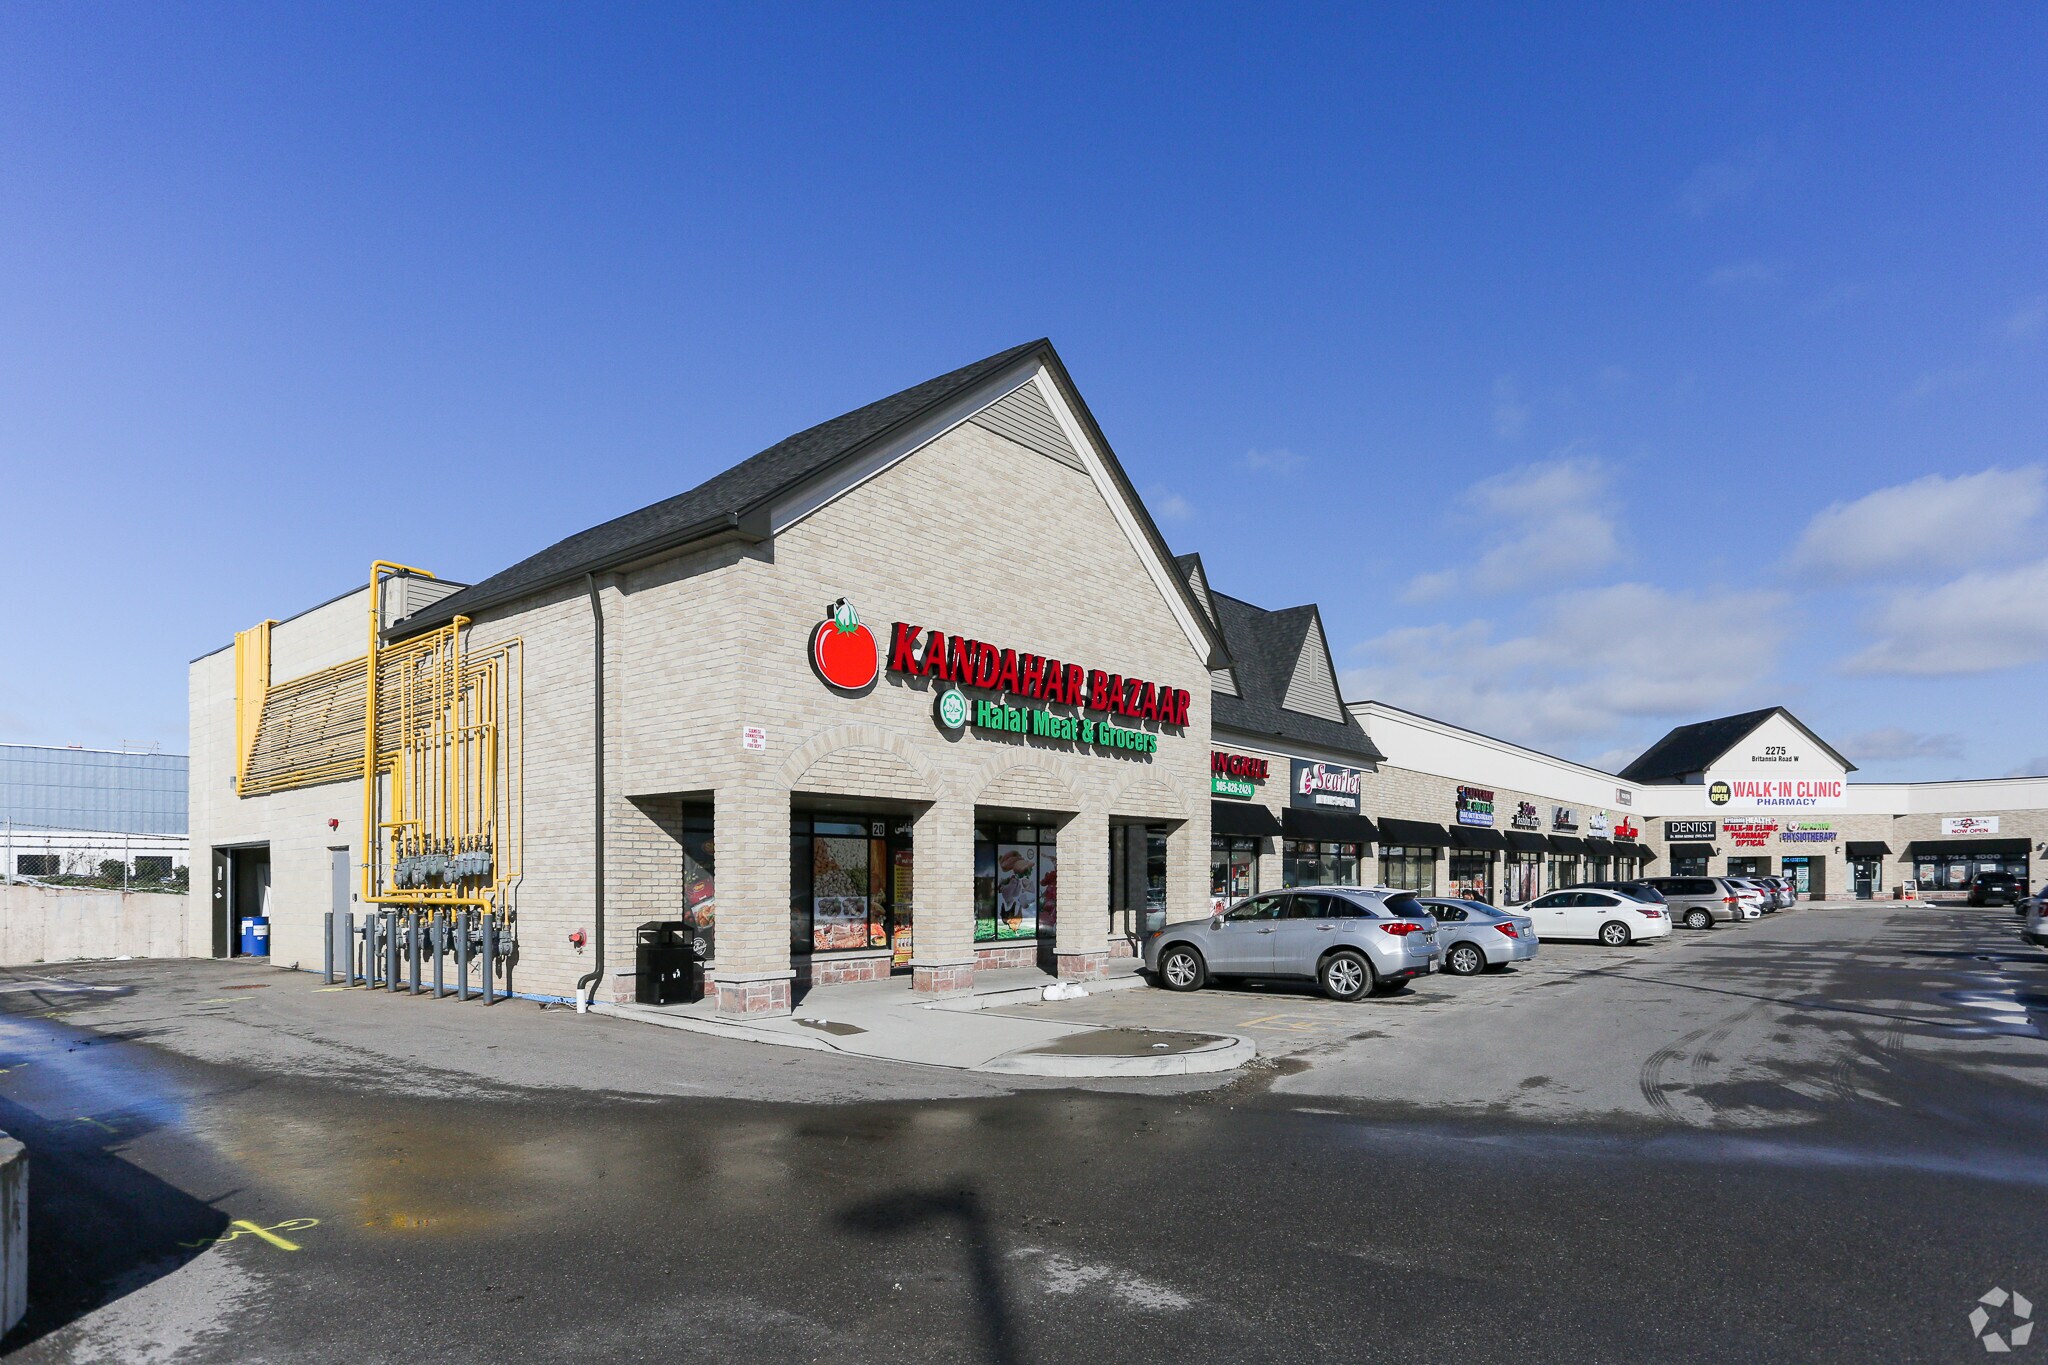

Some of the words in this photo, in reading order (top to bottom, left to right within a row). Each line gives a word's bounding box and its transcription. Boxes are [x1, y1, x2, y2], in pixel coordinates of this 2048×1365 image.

[888, 621, 1084, 707] KANDAHAR
[1087, 669, 1191, 727] BAZAAR
[977, 701, 1028, 736] Halal
[1033, 708, 1078, 742] Meat
[1082, 723, 1094, 744] &
[1099, 723, 1157, 753] Grocers
[1765, 746, 1786, 755] 2275
[1231, 754, 1270, 779] GRILL
[1315, 763, 1361, 795] Scarlet
[1733, 782, 1793, 797] WALK-IN
[1797, 781, 1841, 797] CLINIC
[1711, 793, 1729, 801] OPEN
[1757, 798, 1817, 806] PHARMACY
[873, 824, 884, 835] 20
[1671, 822, 1713, 832] DENTIST
[1755, 824, 1779, 832] CLINIC
[1781, 832, 1838, 841] PHYSIOTHERAPY
[1736, 839, 1766, 847] OPTICAL
